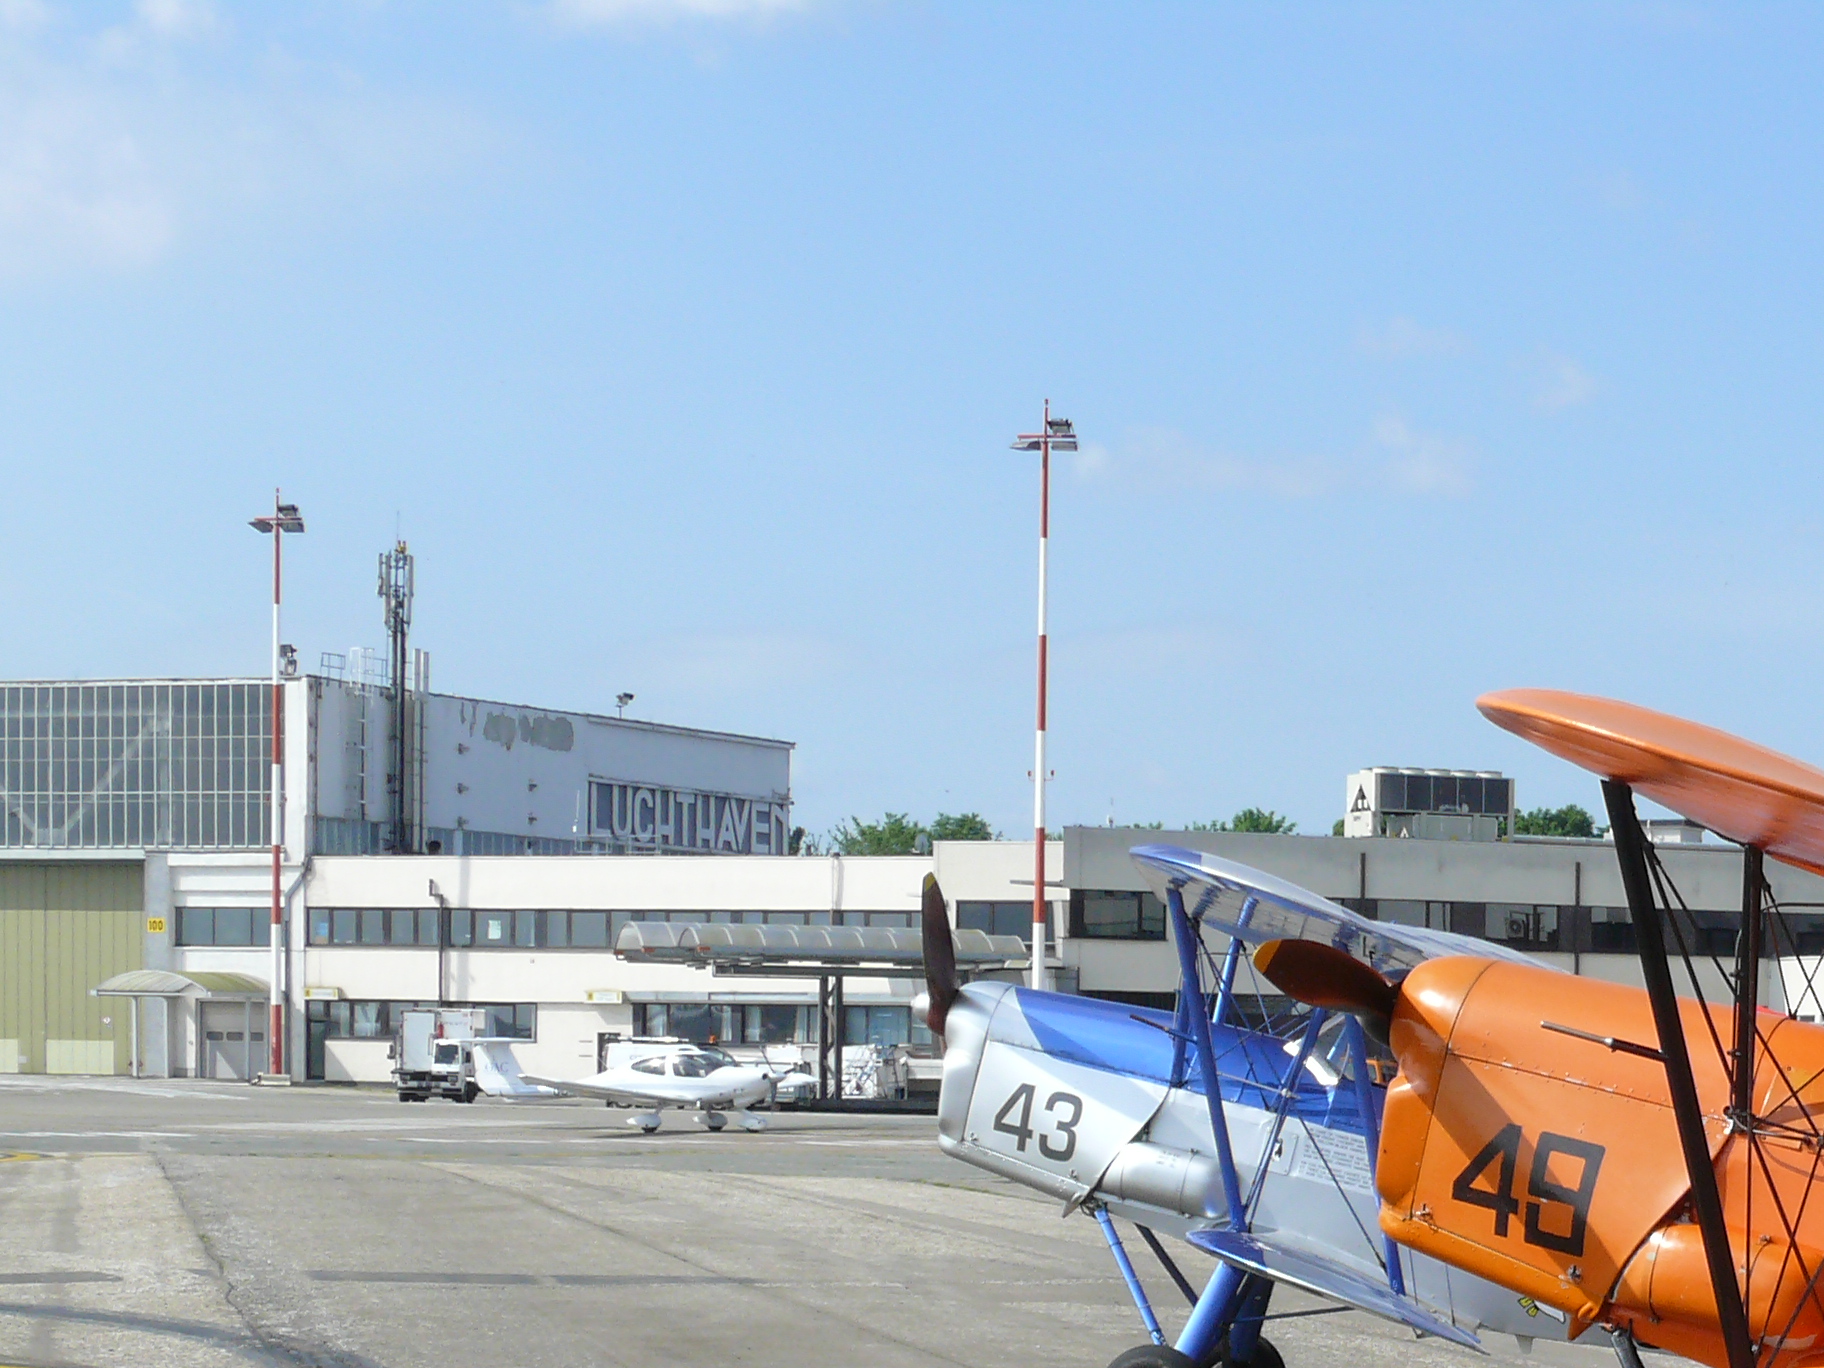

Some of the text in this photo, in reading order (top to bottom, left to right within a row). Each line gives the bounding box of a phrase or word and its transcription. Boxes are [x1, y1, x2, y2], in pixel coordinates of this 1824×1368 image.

[589, 781, 790, 856] LUCHTHAVEN
[148, 919, 164, 931] 100
[993, 1082, 1083, 1162] 43
[1451, 1122, 1606, 1258] 49
